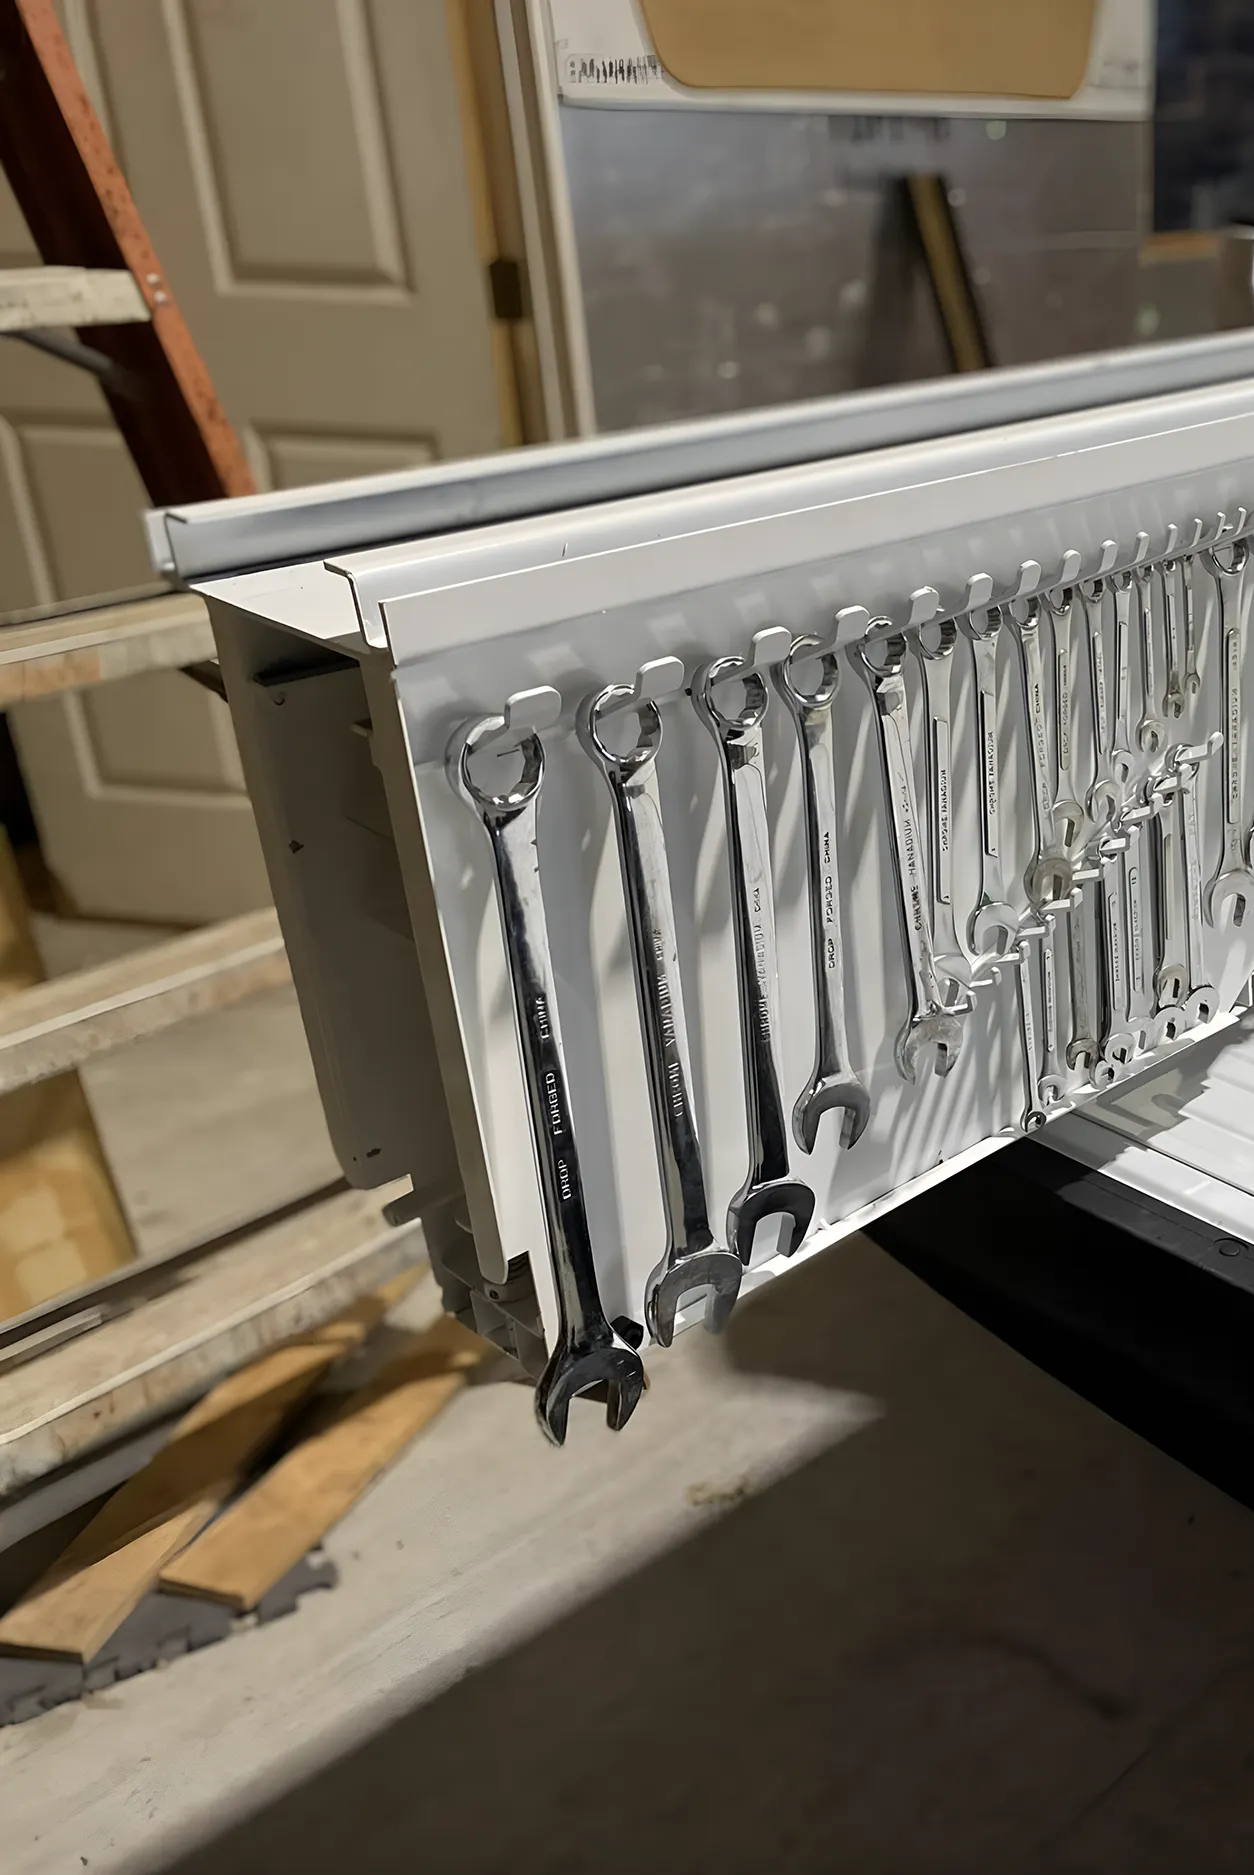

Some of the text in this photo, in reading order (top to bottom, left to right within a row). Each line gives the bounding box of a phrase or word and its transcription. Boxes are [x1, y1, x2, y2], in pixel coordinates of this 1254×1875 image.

[822, 831, 831, 864] CHINA
[826, 937, 836, 969] DROP
[535, 995, 550, 1039] CHINA
[557, 1159, 572, 1200] DROP
